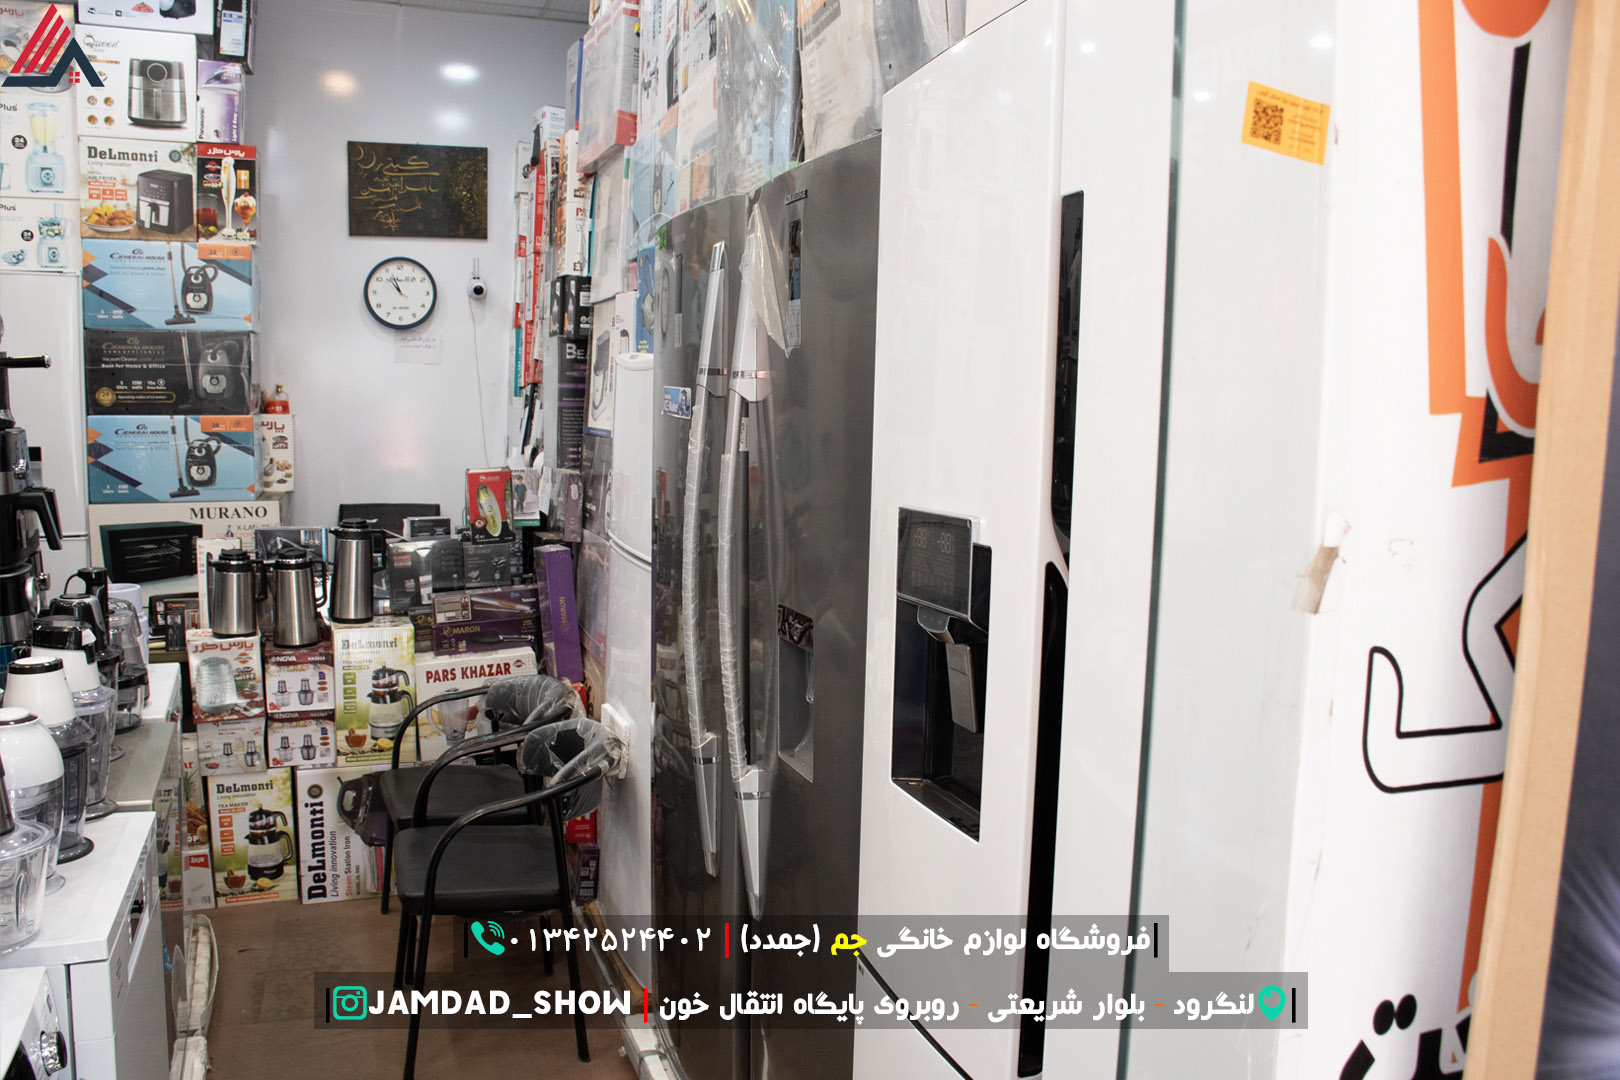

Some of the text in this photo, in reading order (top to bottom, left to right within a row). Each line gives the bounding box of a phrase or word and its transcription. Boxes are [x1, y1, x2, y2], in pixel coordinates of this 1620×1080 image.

[87, 145, 159, 162] DeLmonti
[189, 505, 268, 520] MURANO
[453, 626, 480, 636] MARON
[220, 641, 254, 652] پارس
[426, 662, 511, 684] PARS KHAZAR
[216, 780, 274, 794] DeLmonti
[304, 801, 328, 900] DeLmonti
[329, 830, 341, 897] Living innovation
